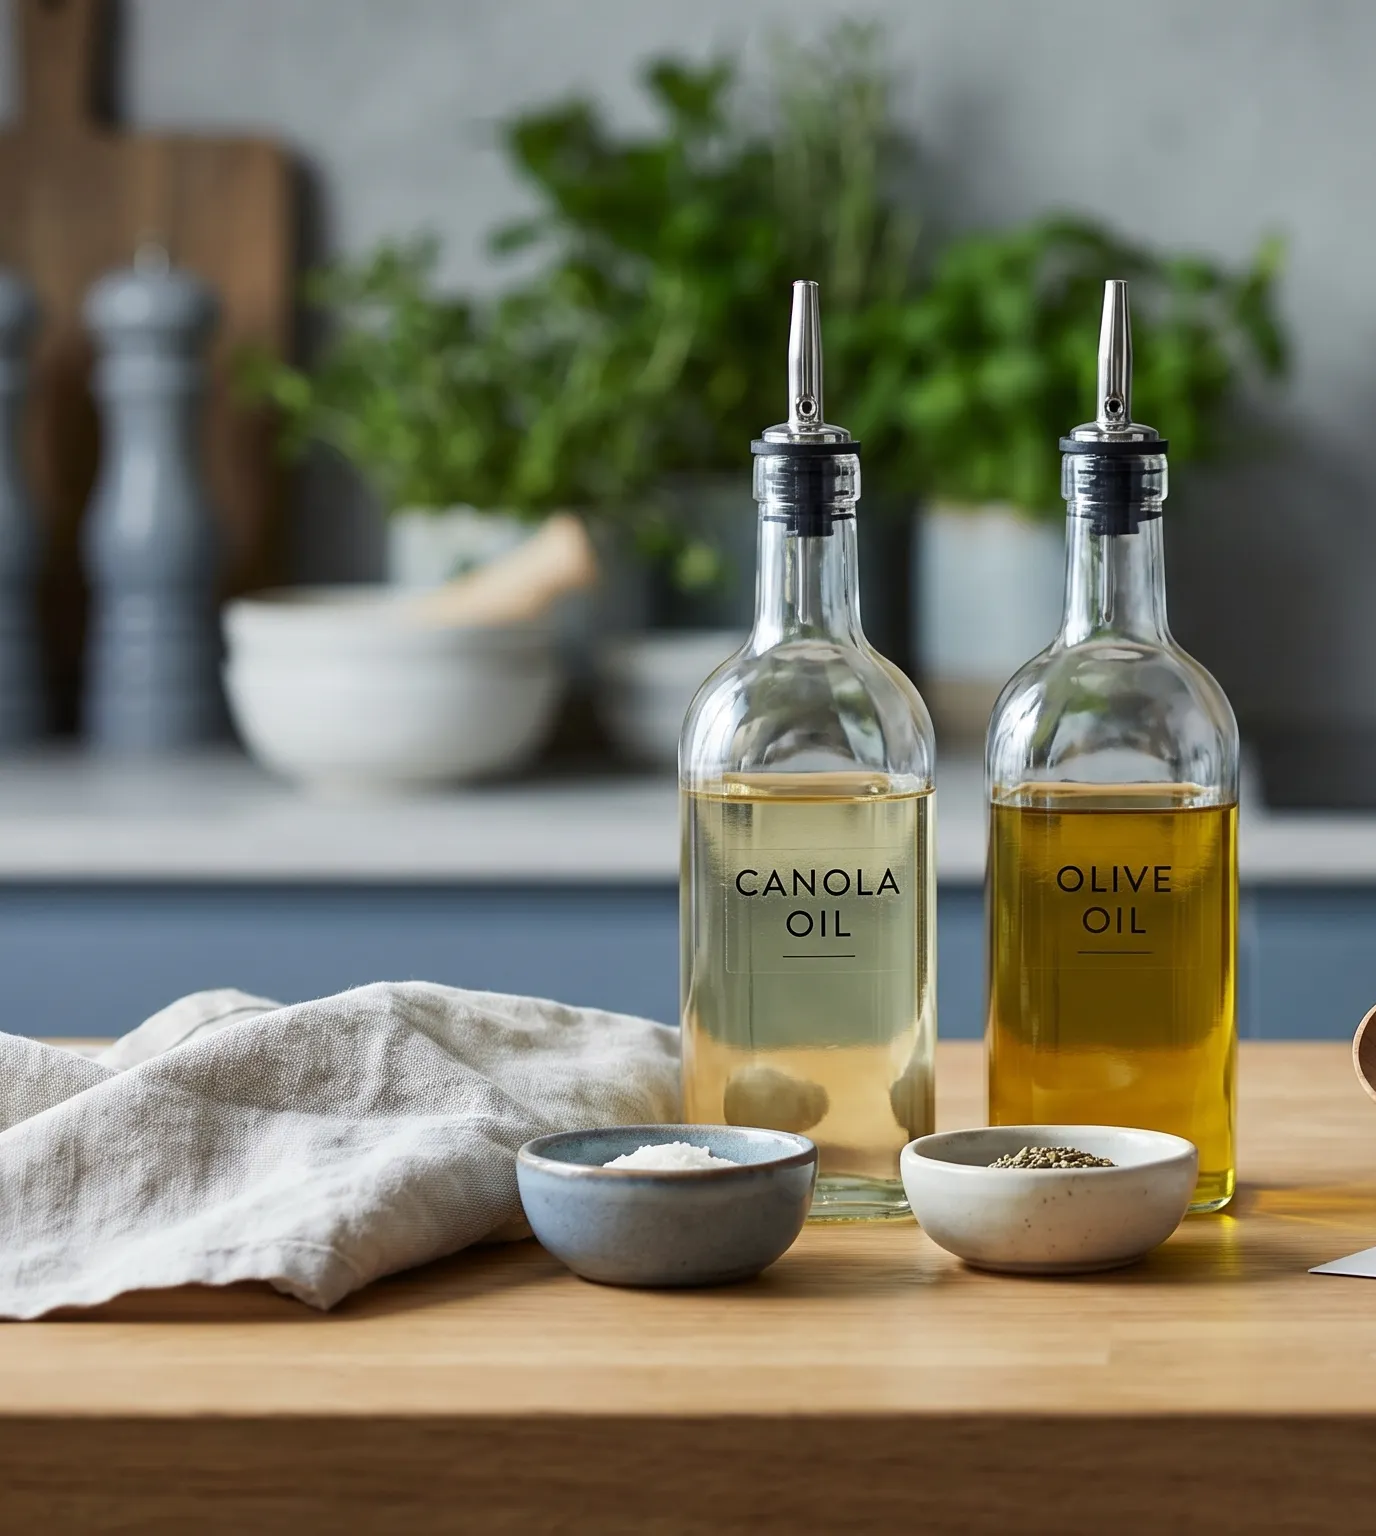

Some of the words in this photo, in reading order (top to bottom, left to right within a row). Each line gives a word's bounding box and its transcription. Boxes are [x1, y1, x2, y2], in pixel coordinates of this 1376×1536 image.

[735, 867, 901, 897] CANOLA
[1056, 865, 1172, 893] OLIVE
[786, 910, 851, 938] OIL
[1082, 906, 1147, 934] OIL
